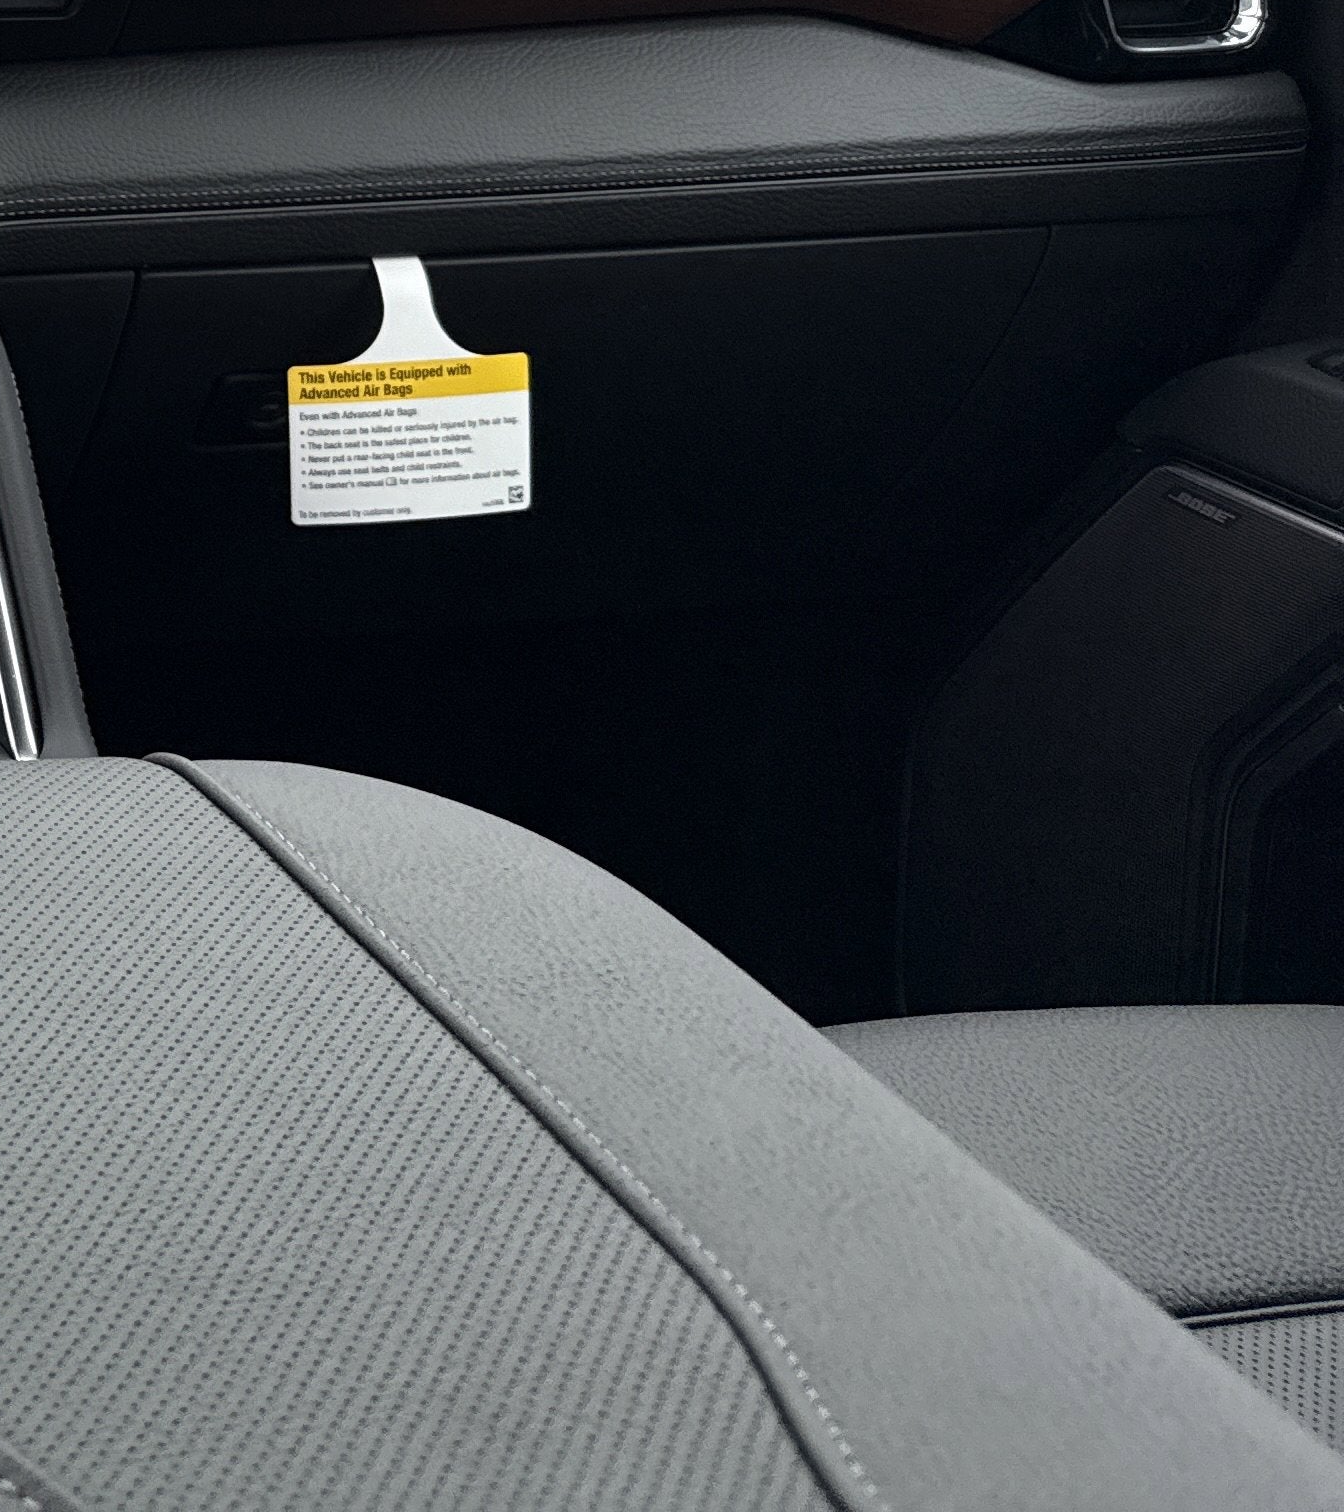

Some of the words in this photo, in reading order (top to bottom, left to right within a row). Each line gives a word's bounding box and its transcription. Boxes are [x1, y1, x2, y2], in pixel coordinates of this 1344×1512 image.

[298, 371, 325, 385] This
[329, 369, 373, 384] Vehicle
[376, 368, 386, 381] is
[389, 365, 443, 382] Equipped
[446, 363, 472, 376] with
[299, 386, 360, 400] Advanced
[363, 384, 381, 398] Air
[384, 383, 413, 398] Bags
[342, 409, 382, 419] Advanced
[1168, 491, 1236, 524] BOSE
